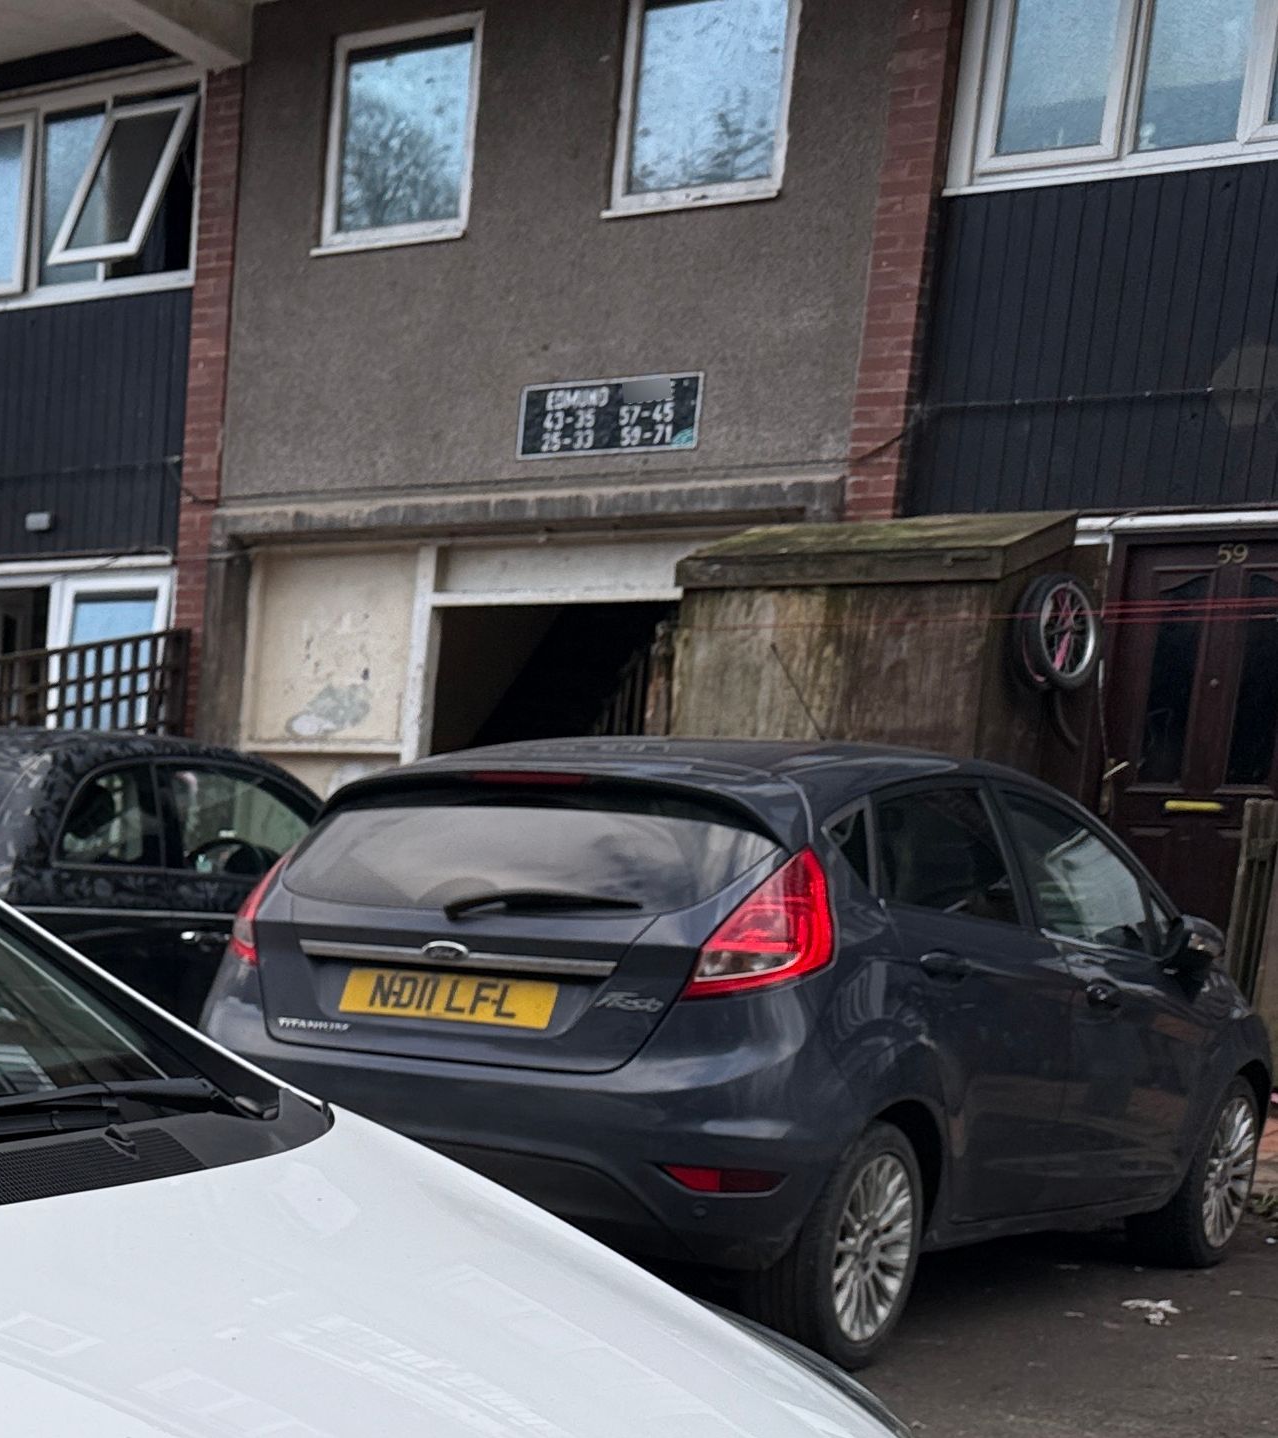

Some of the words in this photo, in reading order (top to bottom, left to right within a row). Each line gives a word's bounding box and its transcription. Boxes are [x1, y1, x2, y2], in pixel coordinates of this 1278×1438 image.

[618, 401, 676, 426] 57-45
[620, 423, 674, 447] 59-71
[1218, 543, 1248, 565] 59
[369, 973, 441, 1010] ND11
[444, 979, 516, 1018] LFL
